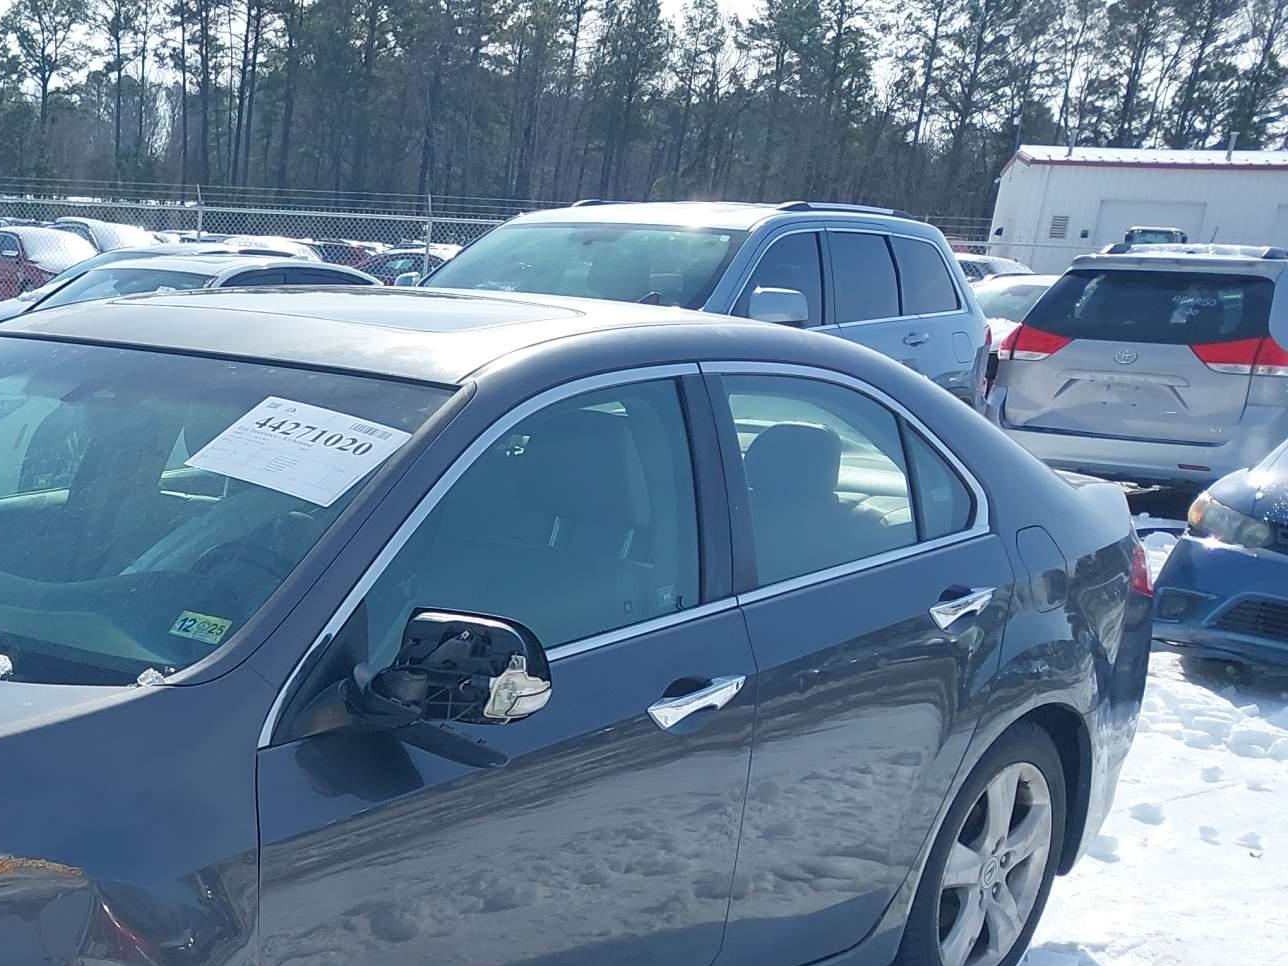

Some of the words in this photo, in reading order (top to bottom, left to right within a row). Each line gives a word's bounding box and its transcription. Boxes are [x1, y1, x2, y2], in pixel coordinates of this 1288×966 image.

[254, 415, 373, 456] 44271020
[178, 616, 198, 633] 12
[207, 622, 226, 636] 25
